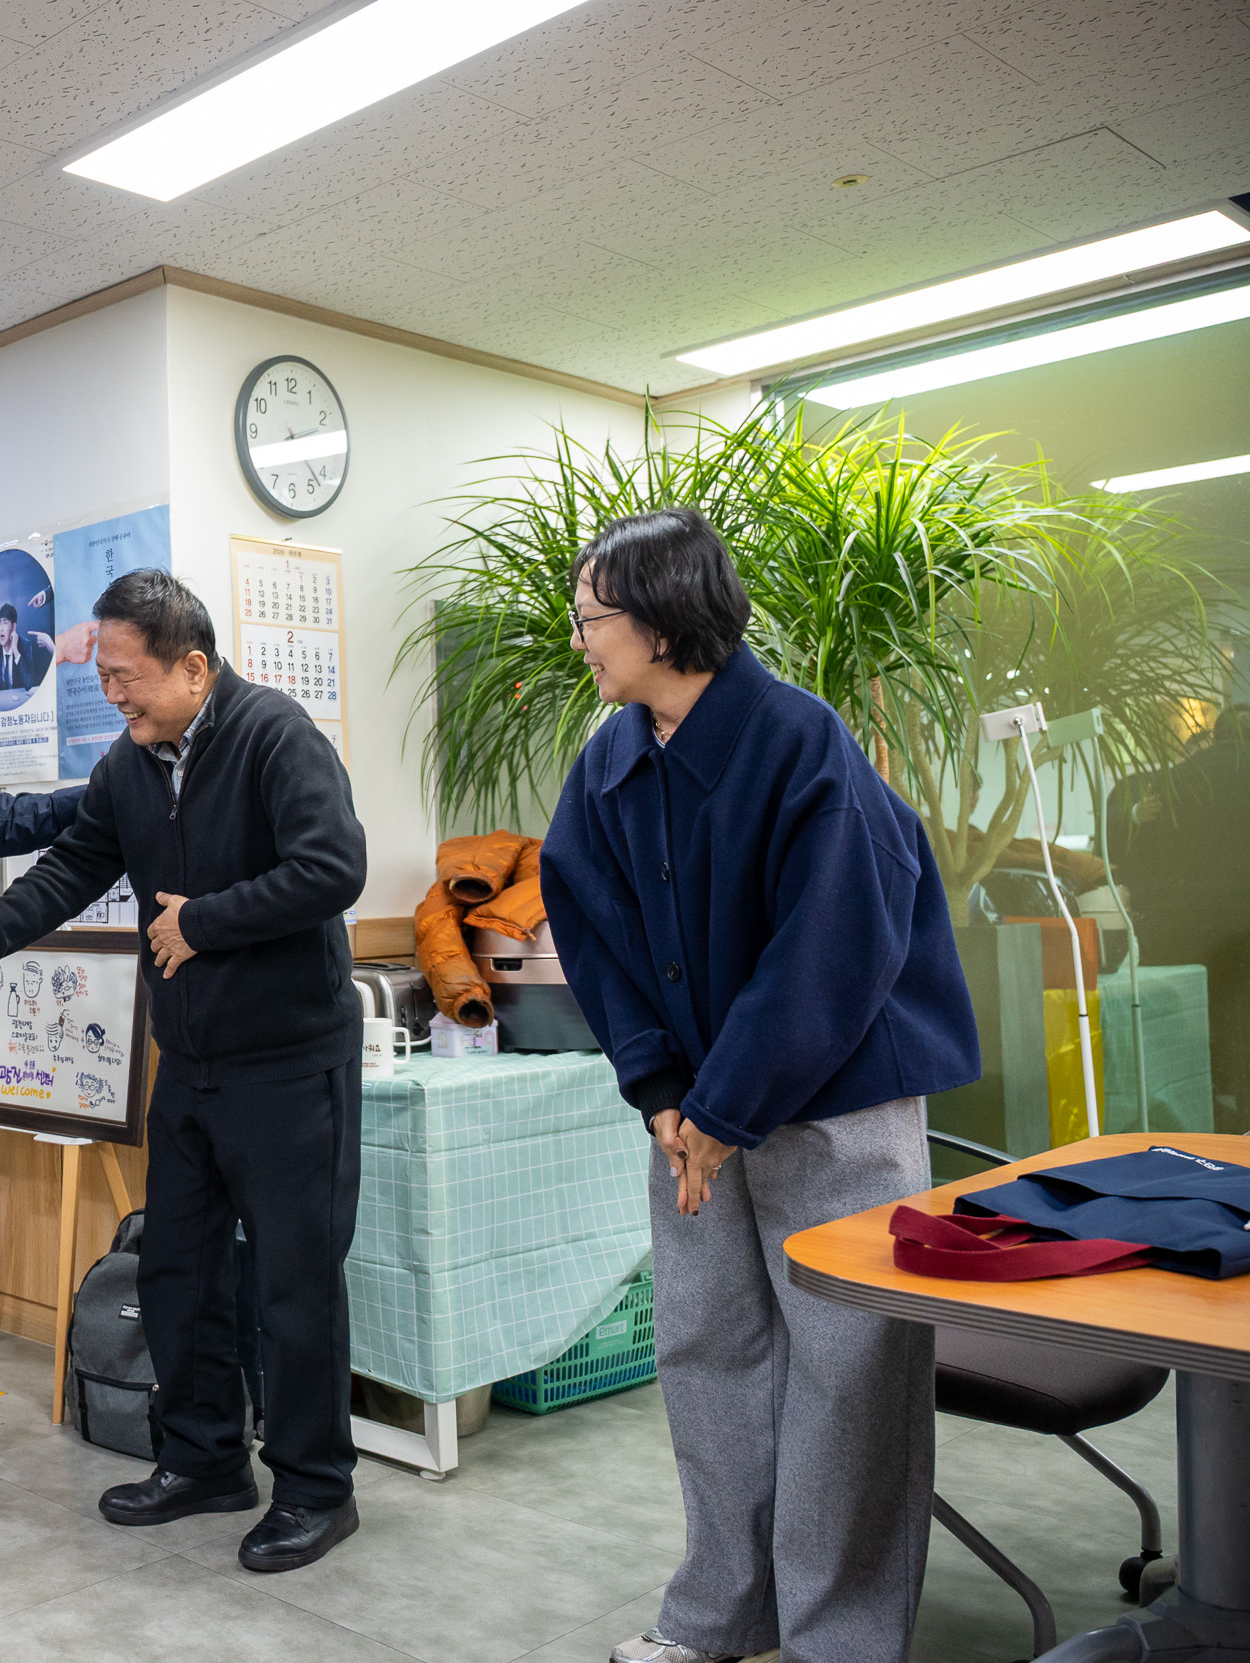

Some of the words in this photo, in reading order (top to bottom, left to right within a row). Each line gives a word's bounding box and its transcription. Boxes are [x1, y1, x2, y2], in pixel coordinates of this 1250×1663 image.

[268, 380, 277, 396] 11
[285, 377, 297, 394] 12
[307, 390, 312, 405] 1
[254, 397, 267, 414] 10
[319, 410, 326, 426] 2
[249, 423, 258, 439] 9
[319, 465, 326, 480] 4
[271, 473, 279, 489] 7
[307, 479, 315, 495] 5
[289, 483, 296, 499] 6
[105, 548, 115, 586] 한국
[286, 560, 289, 569] 1
[259, 600, 265, 608] 19
[312, 606, 319, 614] 23
[259, 610, 266, 618] 26
[313, 616, 320, 624] 30
[287, 631, 294, 643] 2
[248, 646, 251, 654] 1
[261, 647, 266, 656] 2
[275, 648, 280, 657] 3
[288, 650, 293, 658] 4
[302, 651, 307, 659] 5
[315, 652, 320, 660] 6
[328, 653, 333, 661] 7
[248, 659, 253, 668] 8
[261, 660, 267, 669] 9
[274, 661, 282, 671] 10
[288, 663, 295, 671] 11
[301, 664, 309, 673] 12
[314, 665, 322, 674] 13
[327, 666, 335, 674] 14
[246, 672, 255, 681] 15
[260, 673, 269, 683] 16
[275, 674, 282, 683] 17
[288, 675, 296, 685] 18
[301, 677, 309, 685] 19
[314, 678, 323, 687] 20
[327, 679, 335, 687] 21
[288, 689, 297, 697] 25
[301, 690, 310, 698] 26
[315, 691, 323, 699] 27
[328, 691, 337, 700] 28
[0, 1065, 22, 1085] 광진
